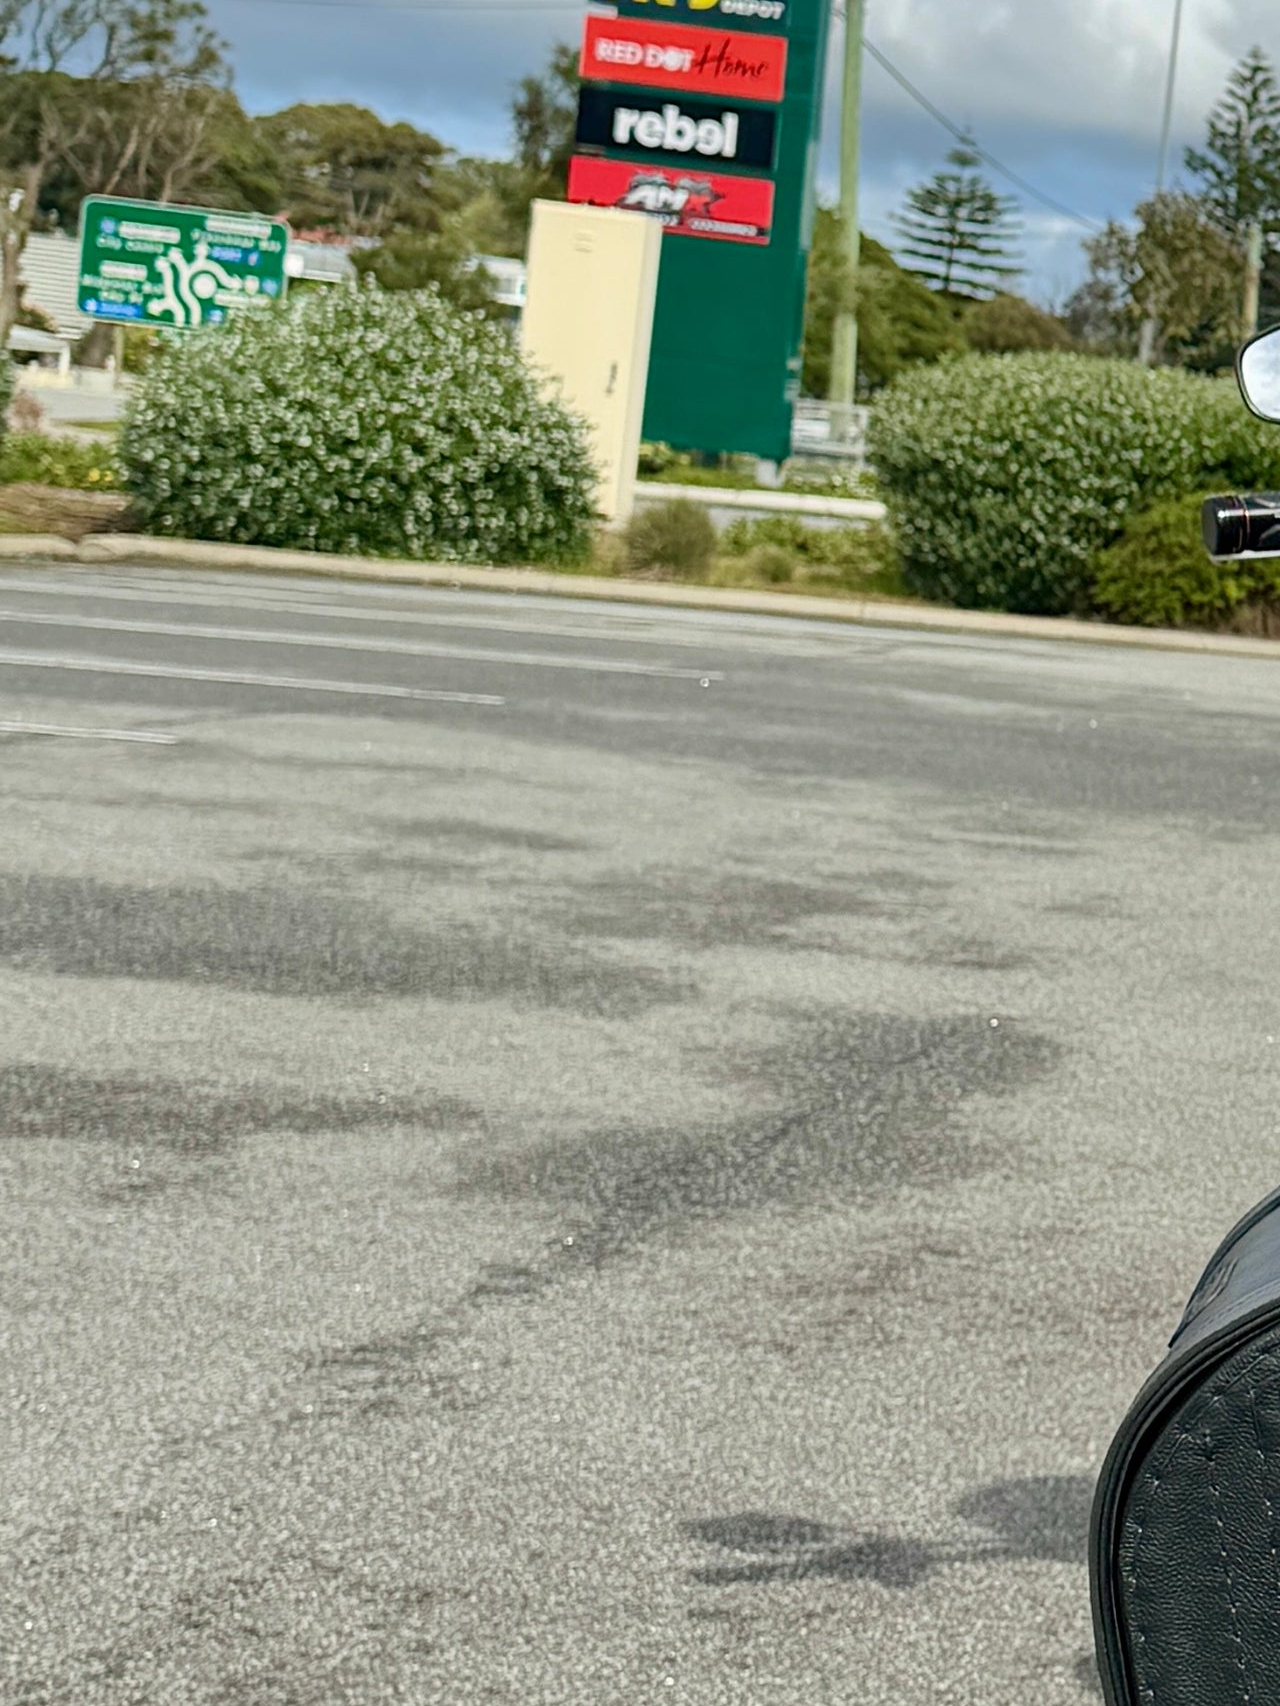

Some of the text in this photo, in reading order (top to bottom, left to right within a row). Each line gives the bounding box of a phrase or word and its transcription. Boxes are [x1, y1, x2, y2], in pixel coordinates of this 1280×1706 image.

[720, 0, 785, 20] DEPOT
[595, 37, 769, 78] RED DOT Home
[613, 104, 739, 158] rebel
